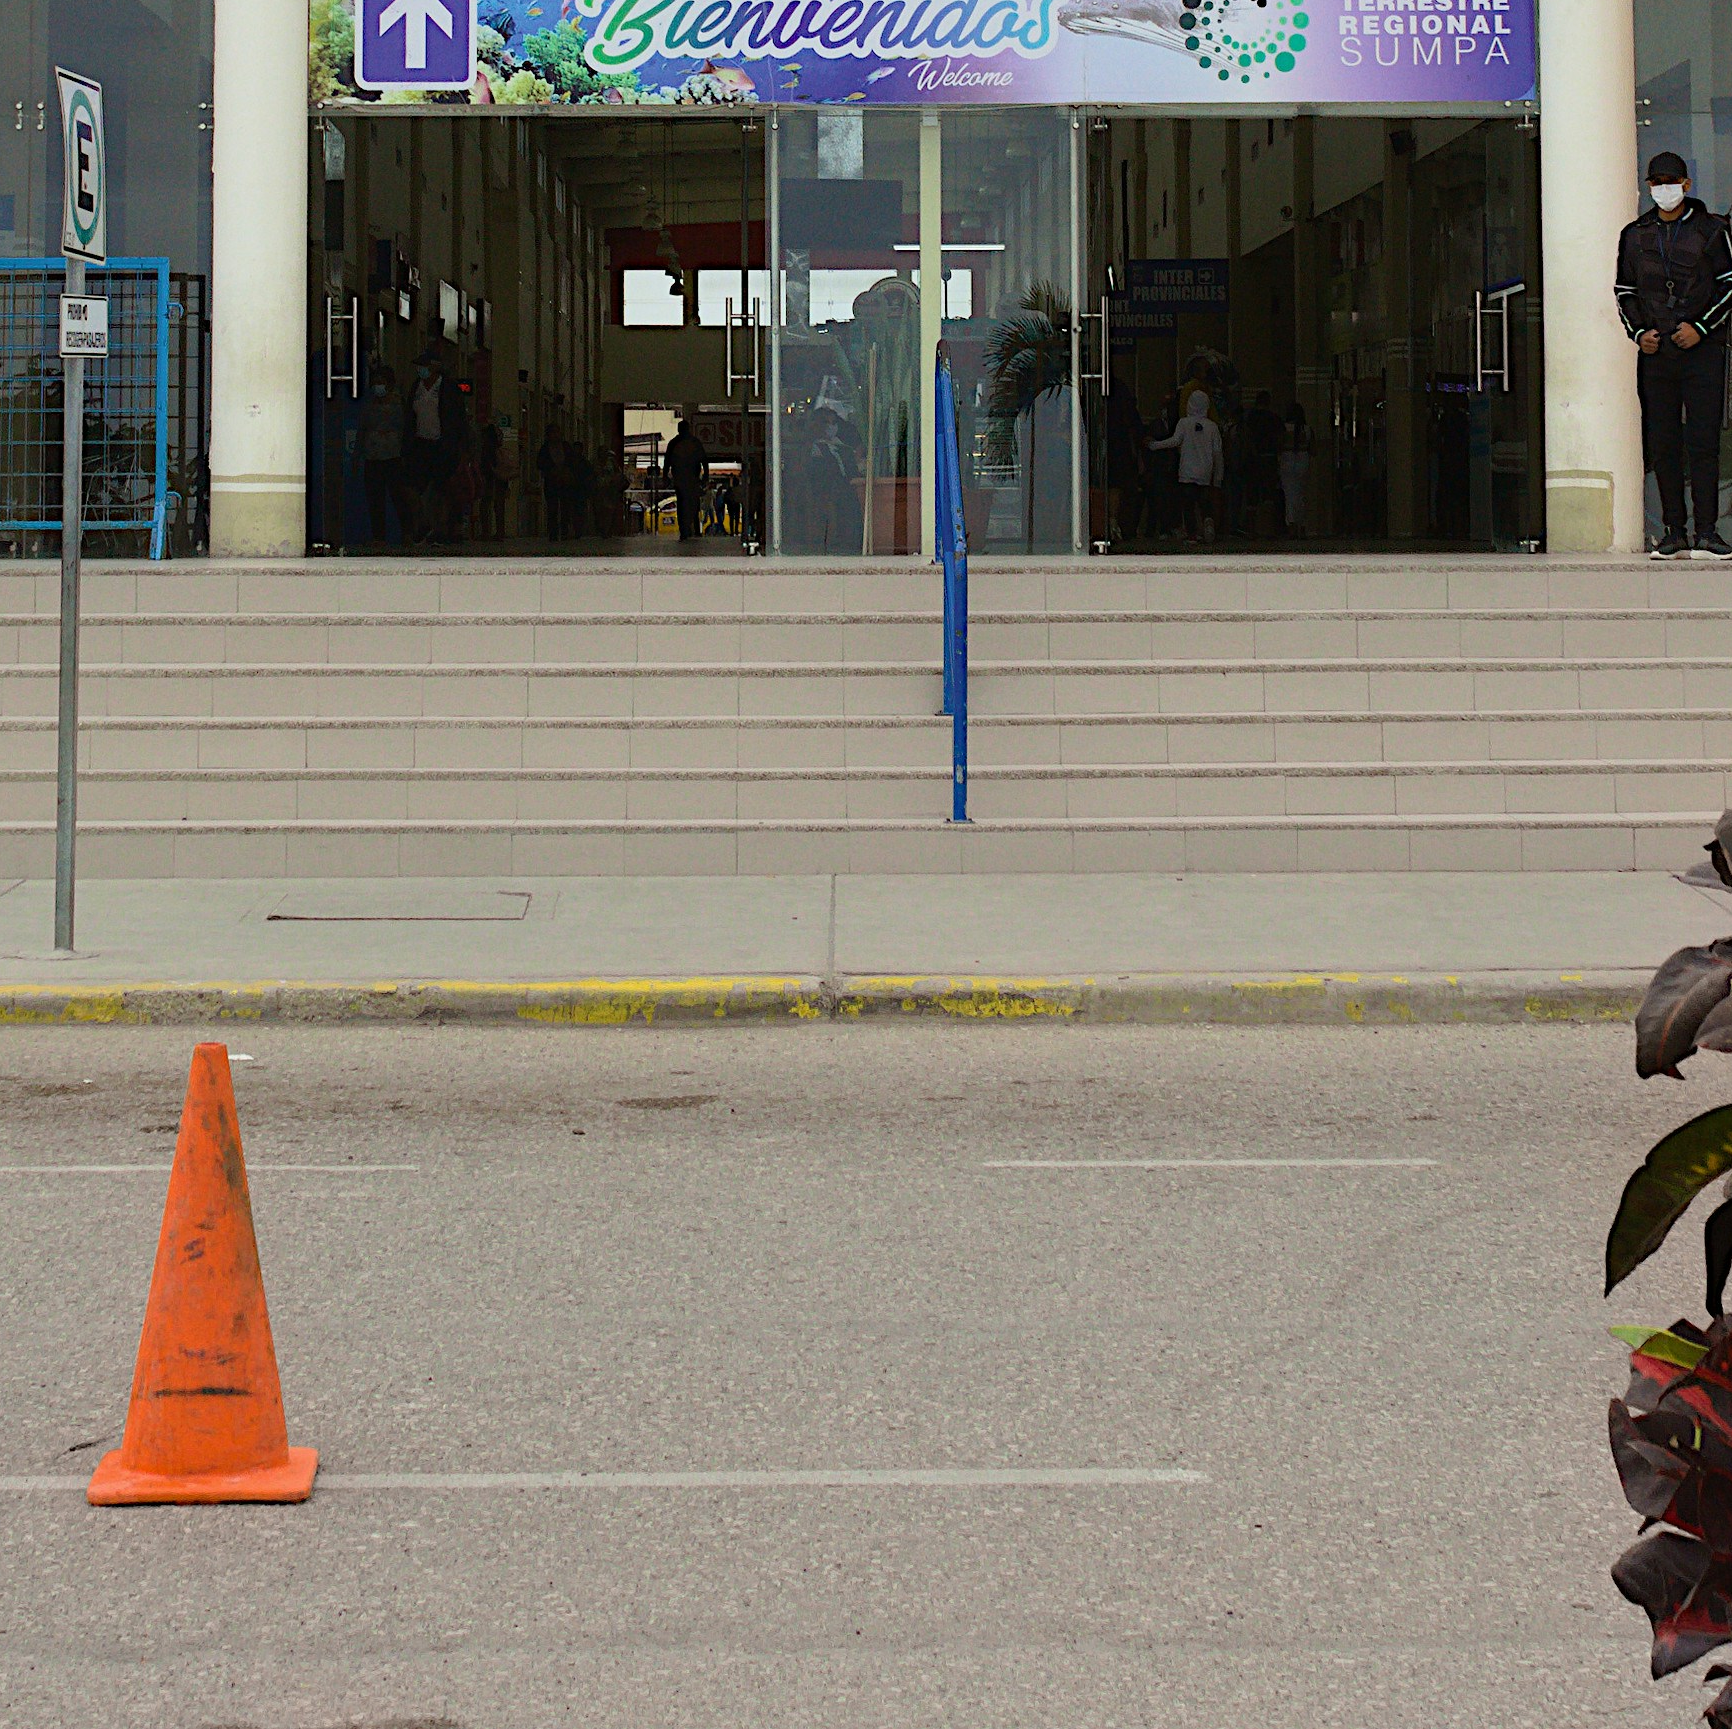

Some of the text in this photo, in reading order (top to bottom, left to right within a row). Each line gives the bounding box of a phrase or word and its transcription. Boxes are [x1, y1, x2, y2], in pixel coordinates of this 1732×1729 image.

[1338, 14, 1512, 36] REGIONAL
[1340, 36, 1511, 67] SUMPA
[907, 59, 1014, 92] Welcome
[76, 119, 95, 214] E
[1152, 269, 1194, 286] INTER
[1132, 284, 1227, 303] PROVINCIALES
